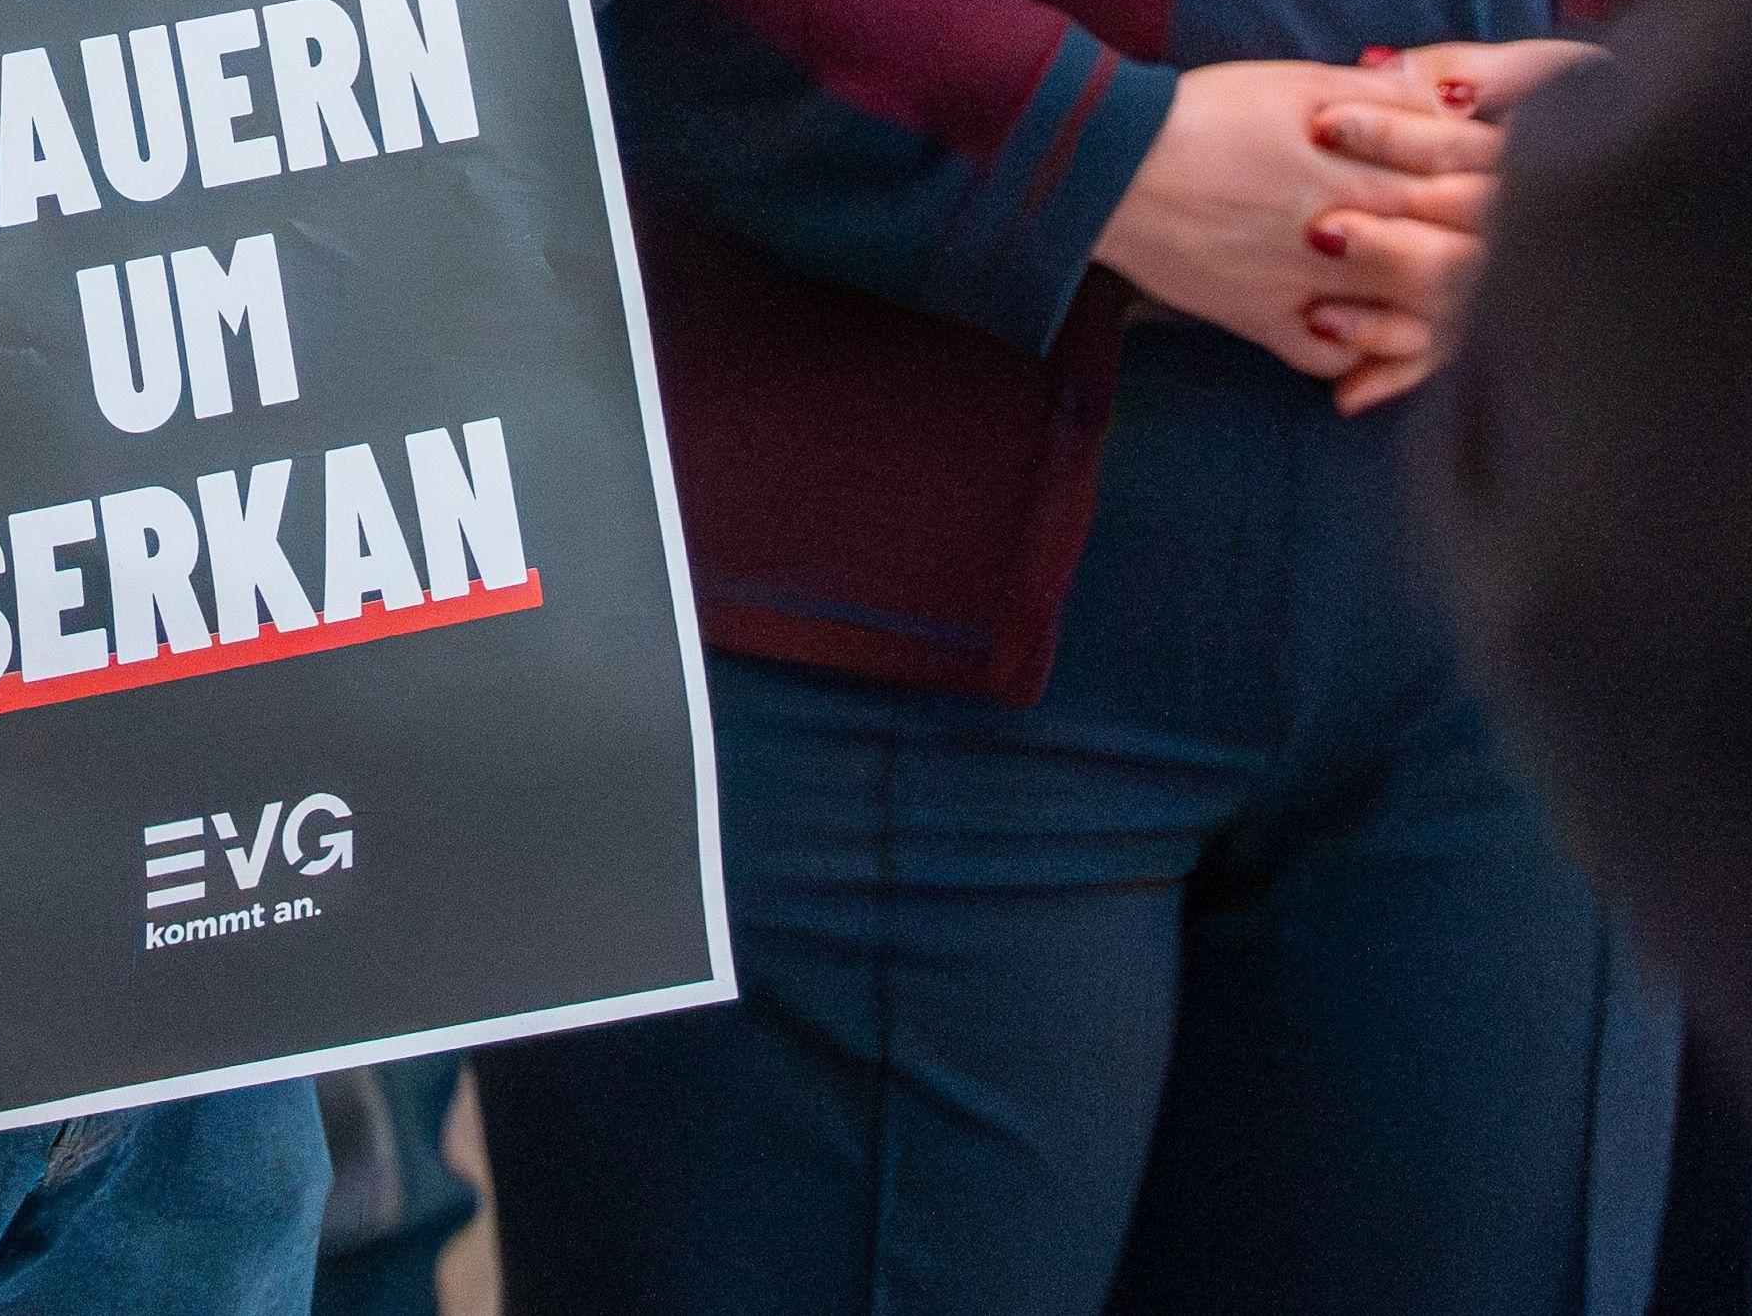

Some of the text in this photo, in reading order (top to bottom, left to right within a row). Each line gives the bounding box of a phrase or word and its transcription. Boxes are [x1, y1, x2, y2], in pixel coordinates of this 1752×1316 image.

[76, 233, 300, 435] UM
[144, 792, 353, 910] EVG
[146, 896, 322, 950] kommt an.
